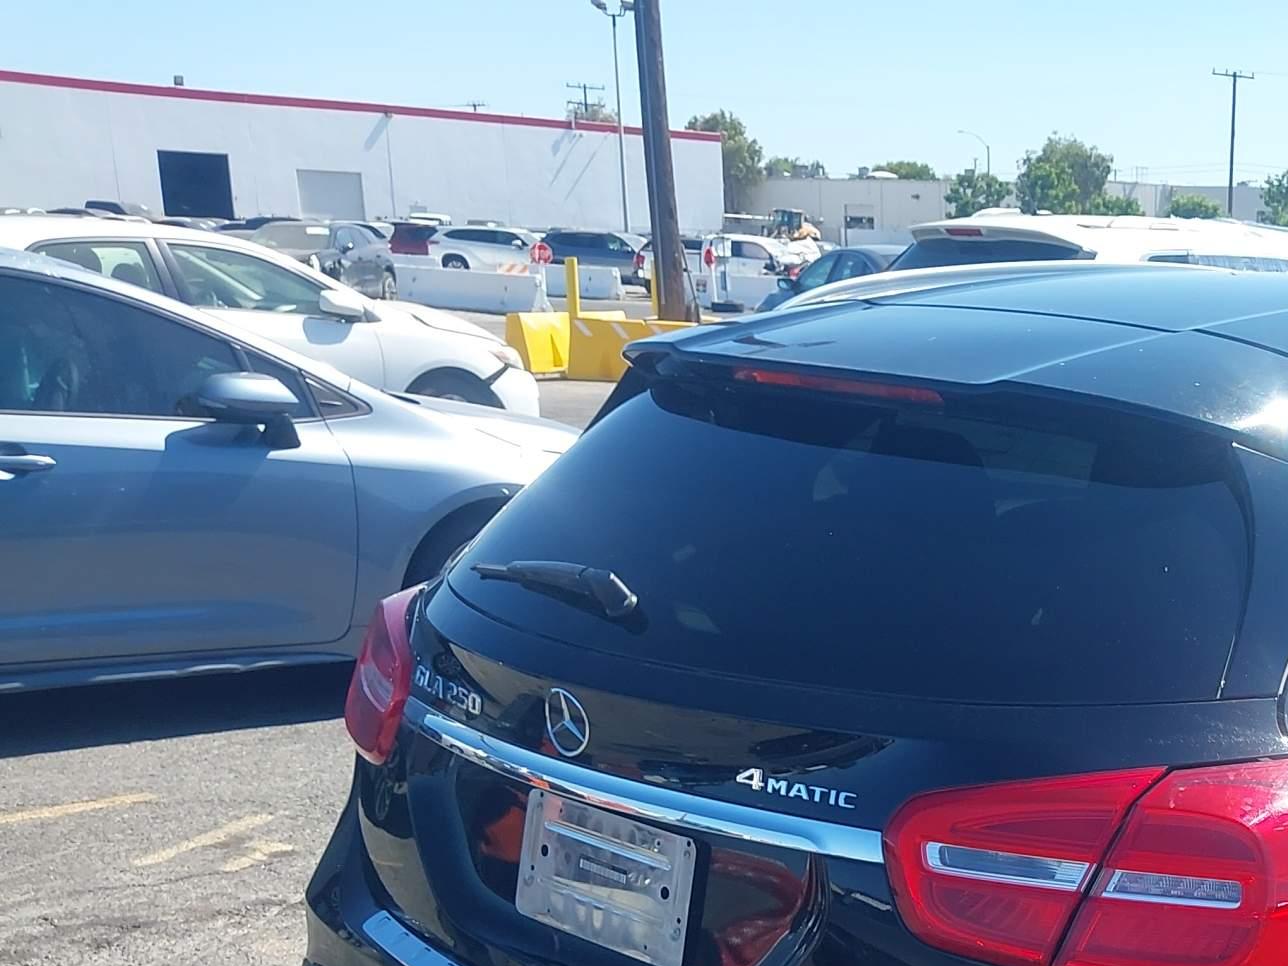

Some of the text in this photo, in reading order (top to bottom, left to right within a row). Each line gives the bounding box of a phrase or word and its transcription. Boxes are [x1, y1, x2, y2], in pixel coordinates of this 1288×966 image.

[414, 664, 482, 716] GLA 250
[736, 768, 857, 809] 4MATIC
